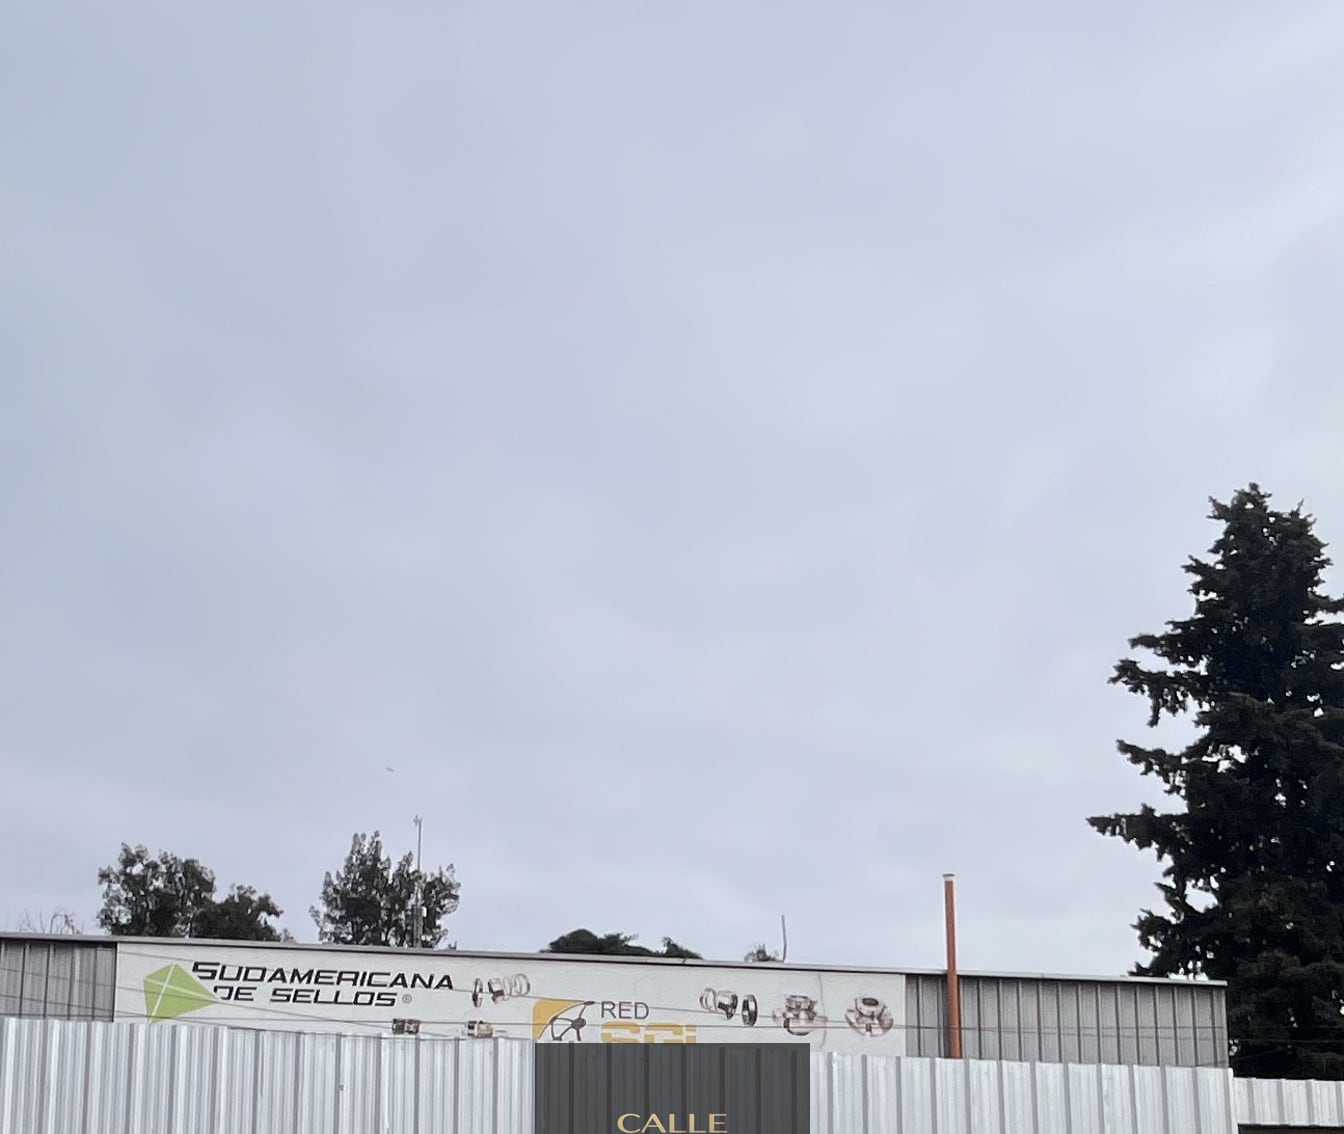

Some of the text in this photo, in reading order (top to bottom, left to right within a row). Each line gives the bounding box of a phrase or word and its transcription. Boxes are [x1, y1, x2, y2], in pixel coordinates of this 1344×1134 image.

[191, 961, 454, 990] SUDAMERICANA
[213, 985, 398, 1007] DE SELLOS
[601, 1000, 650, 1020] RED
